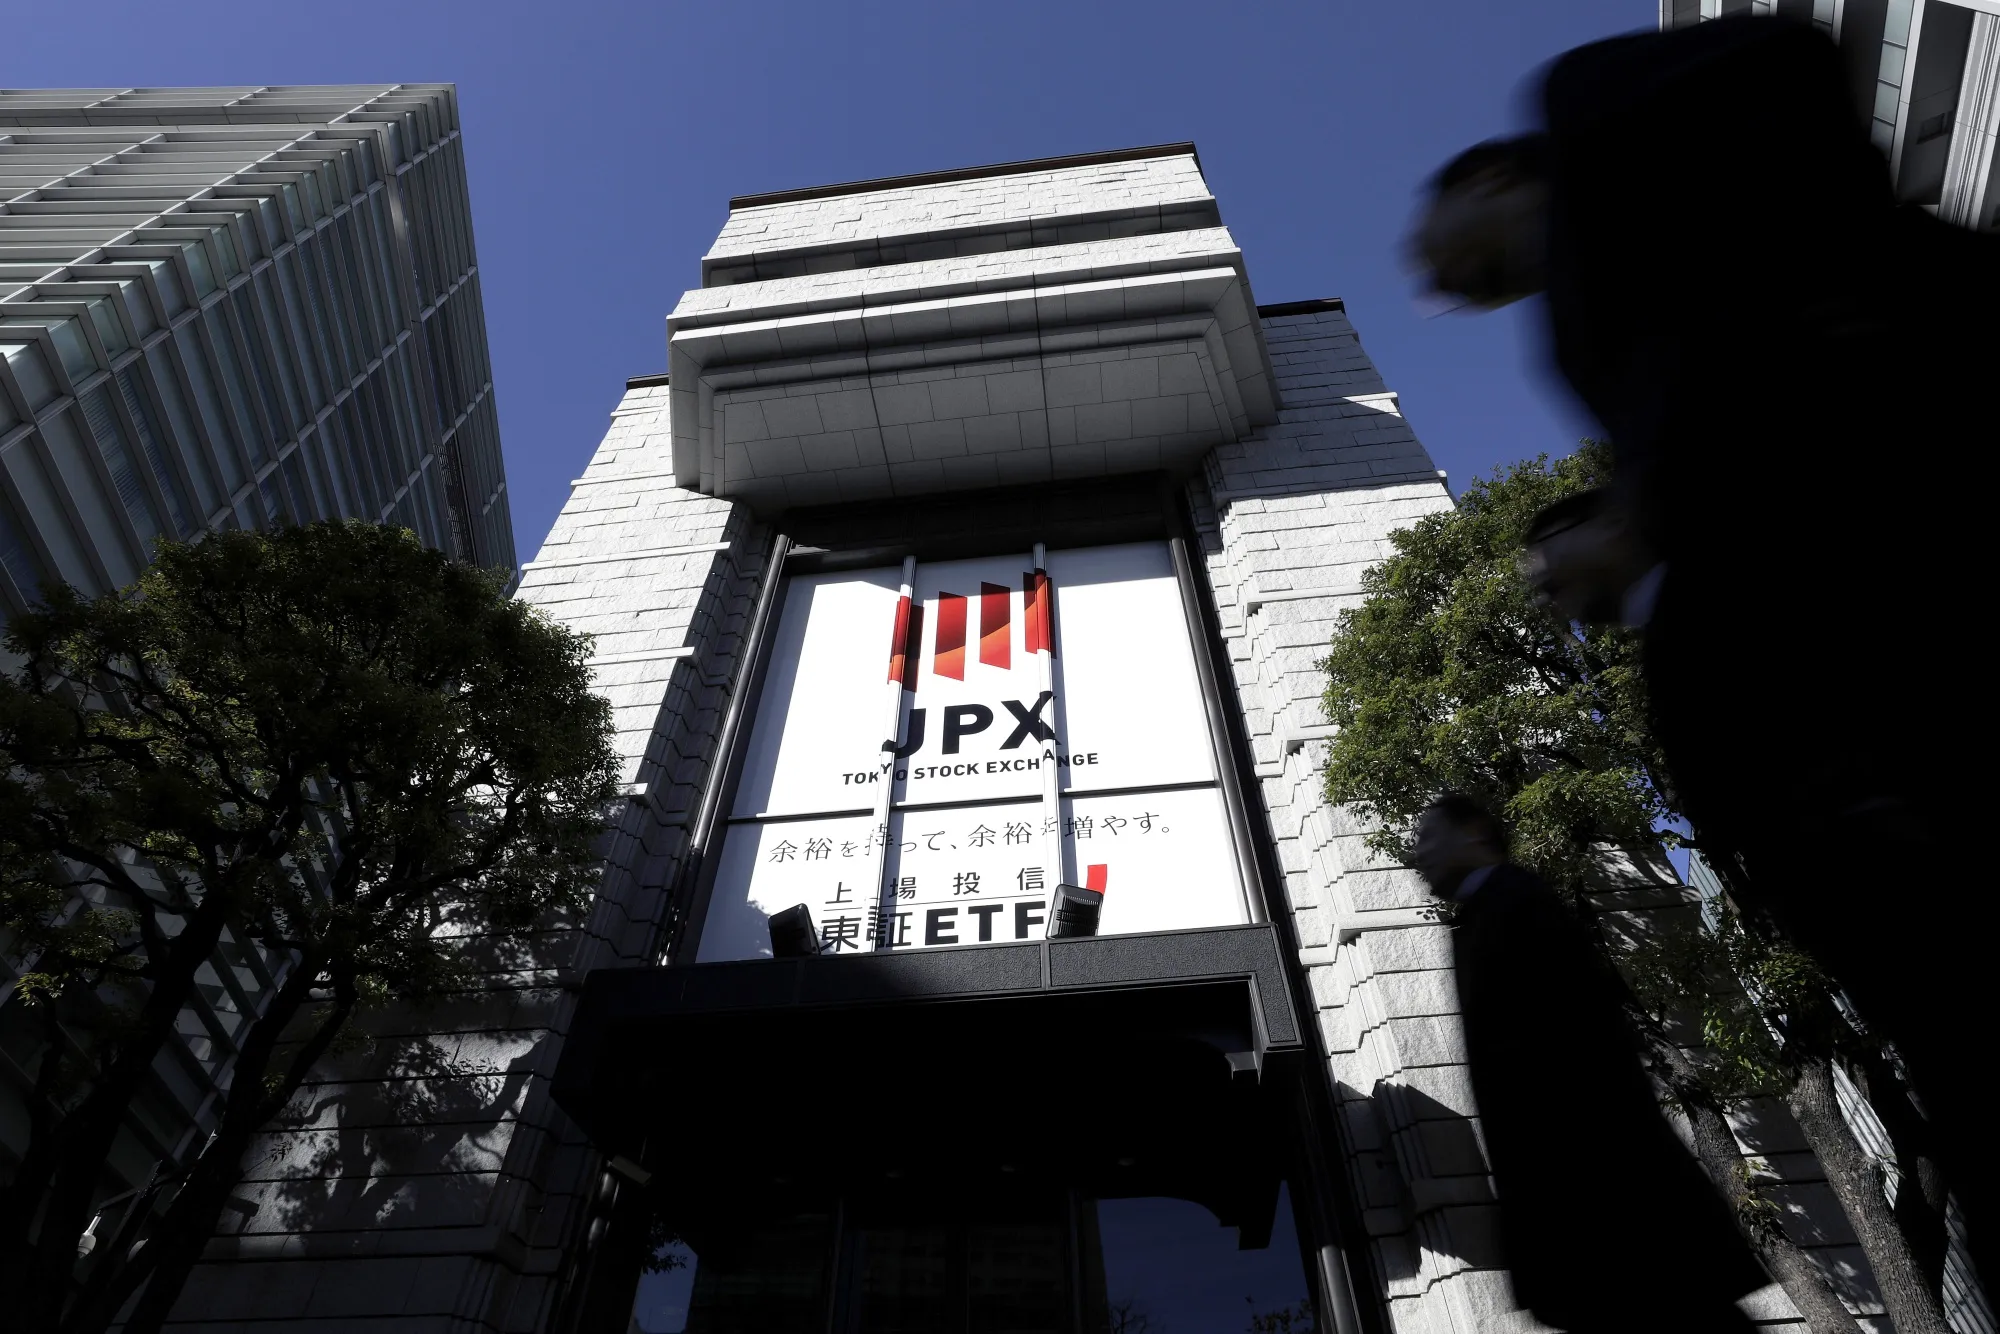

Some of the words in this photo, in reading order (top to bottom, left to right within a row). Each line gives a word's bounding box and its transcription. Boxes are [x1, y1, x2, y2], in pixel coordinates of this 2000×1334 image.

[881, 691, 1061, 759] JPX
[843, 763, 908, 785] TOKYO
[914, 763, 980, 779] STOCK
[986, 749, 1099, 774] EXCHANGE
[825, 867, 1045, 904] 上場投信
[820, 901, 1046, 952] 東証ETF
